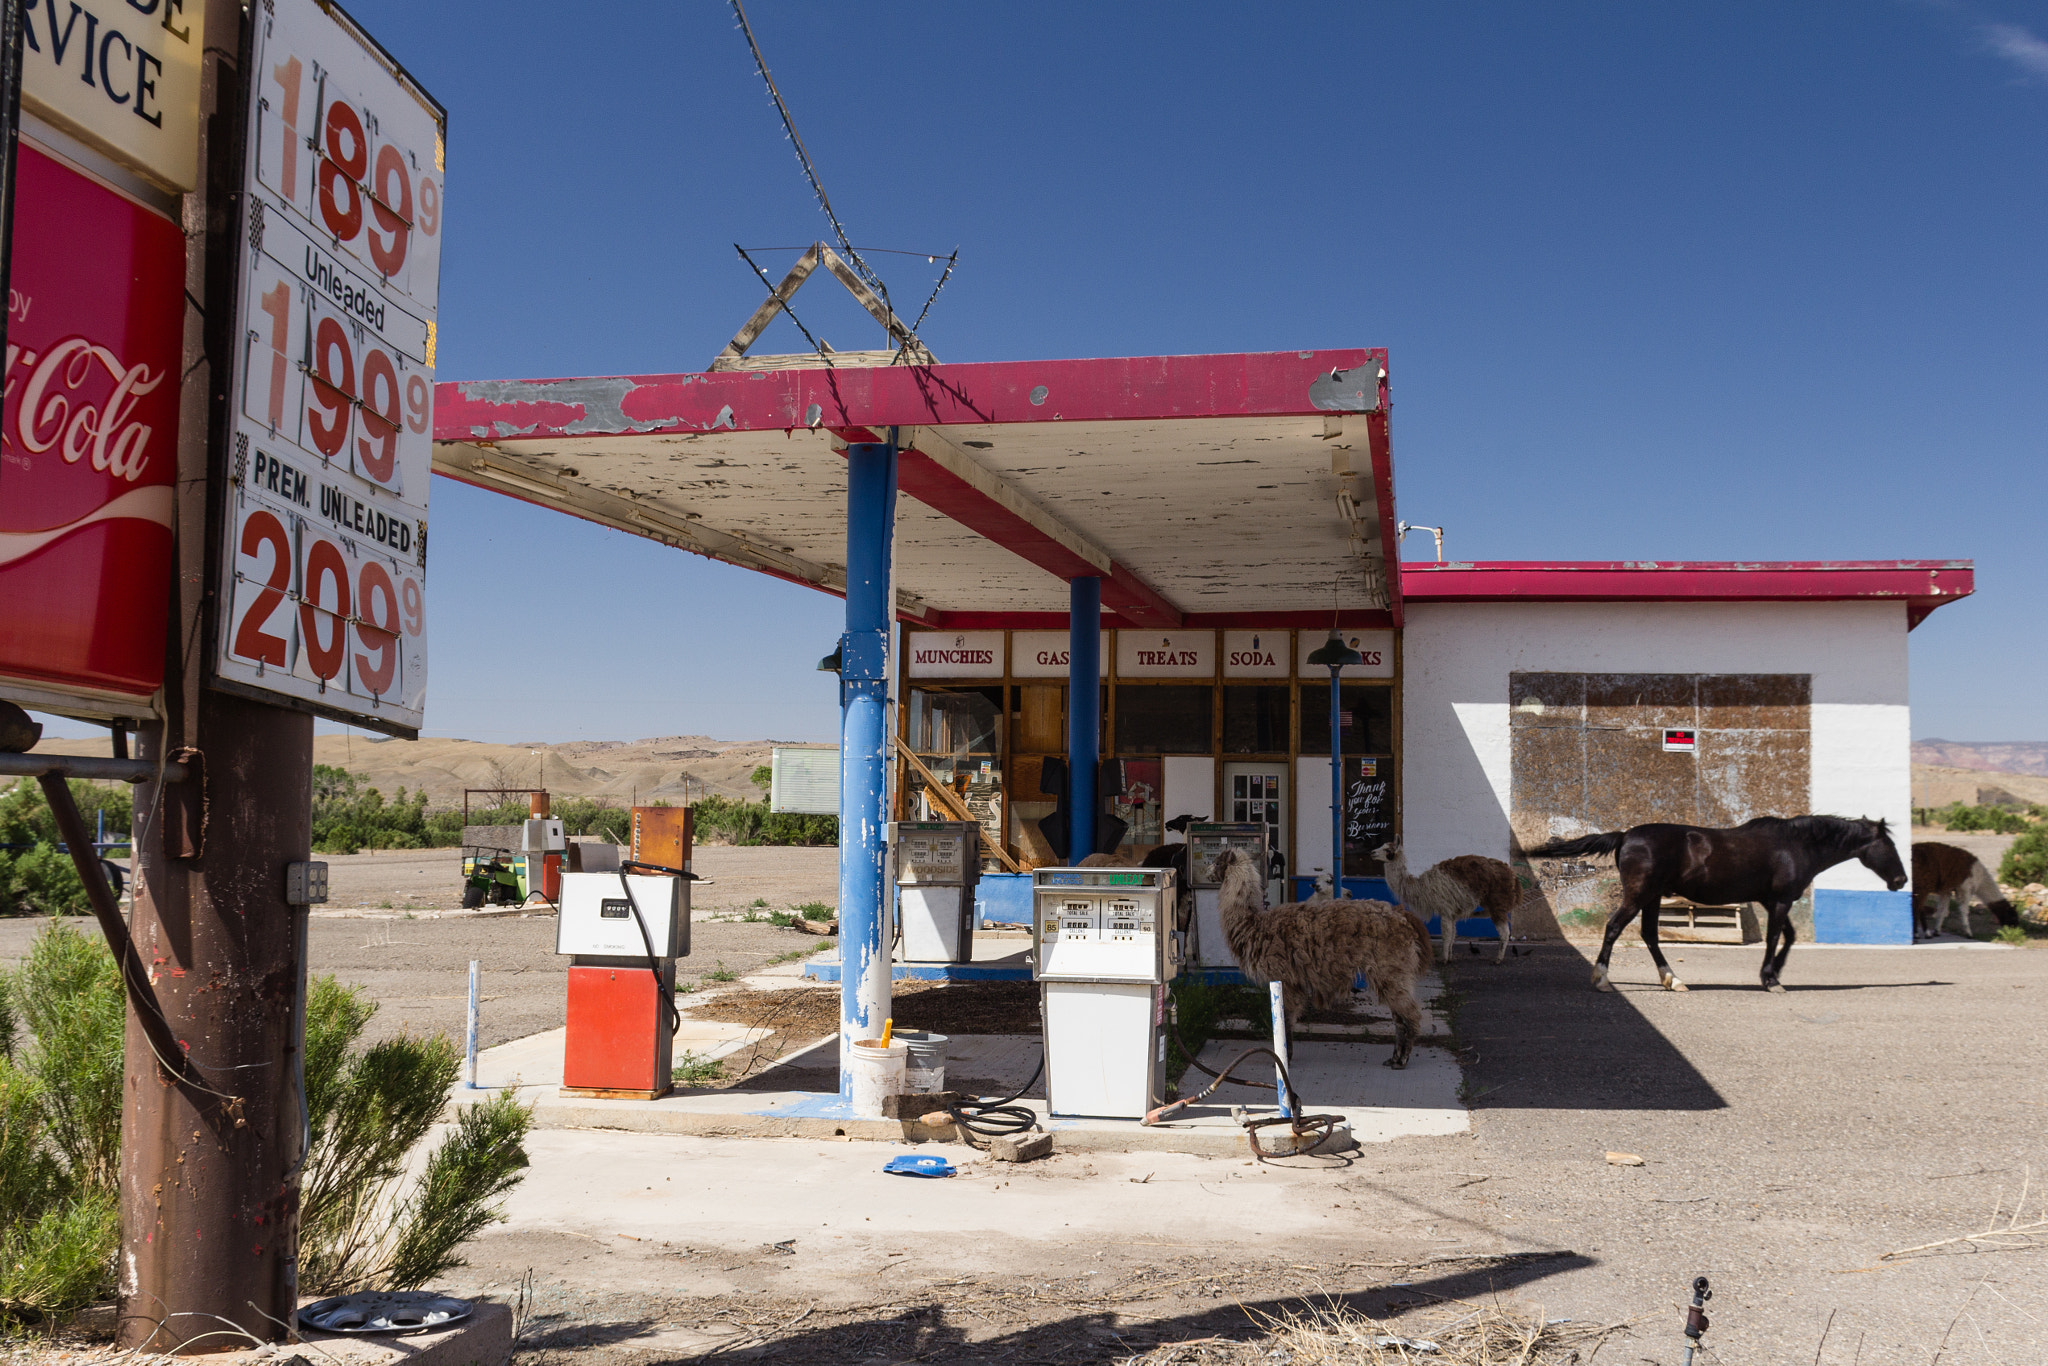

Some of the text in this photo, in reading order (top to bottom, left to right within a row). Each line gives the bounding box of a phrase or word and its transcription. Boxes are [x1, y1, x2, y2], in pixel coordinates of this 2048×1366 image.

[304, 245, 386, 332] Unleaded
[254, 451, 412, 554] PREM. UNLEADED
[915, 650, 993, 664] MUNCHIES
[1036, 651, 1070, 665] GAS
[1137, 651, 1198, 666] TREATS
[1229, 651, 1276, 666] SODA
[1351, 781, 1386, 797] Thank
[1348, 794, 1384, 812] you for
[1353, 807, 1380, 819] your
[1346, 820, 1390, 837] Business
[907, 865, 959, 874] WOODSIDE
[1046, 924, 1057, 932] 85
